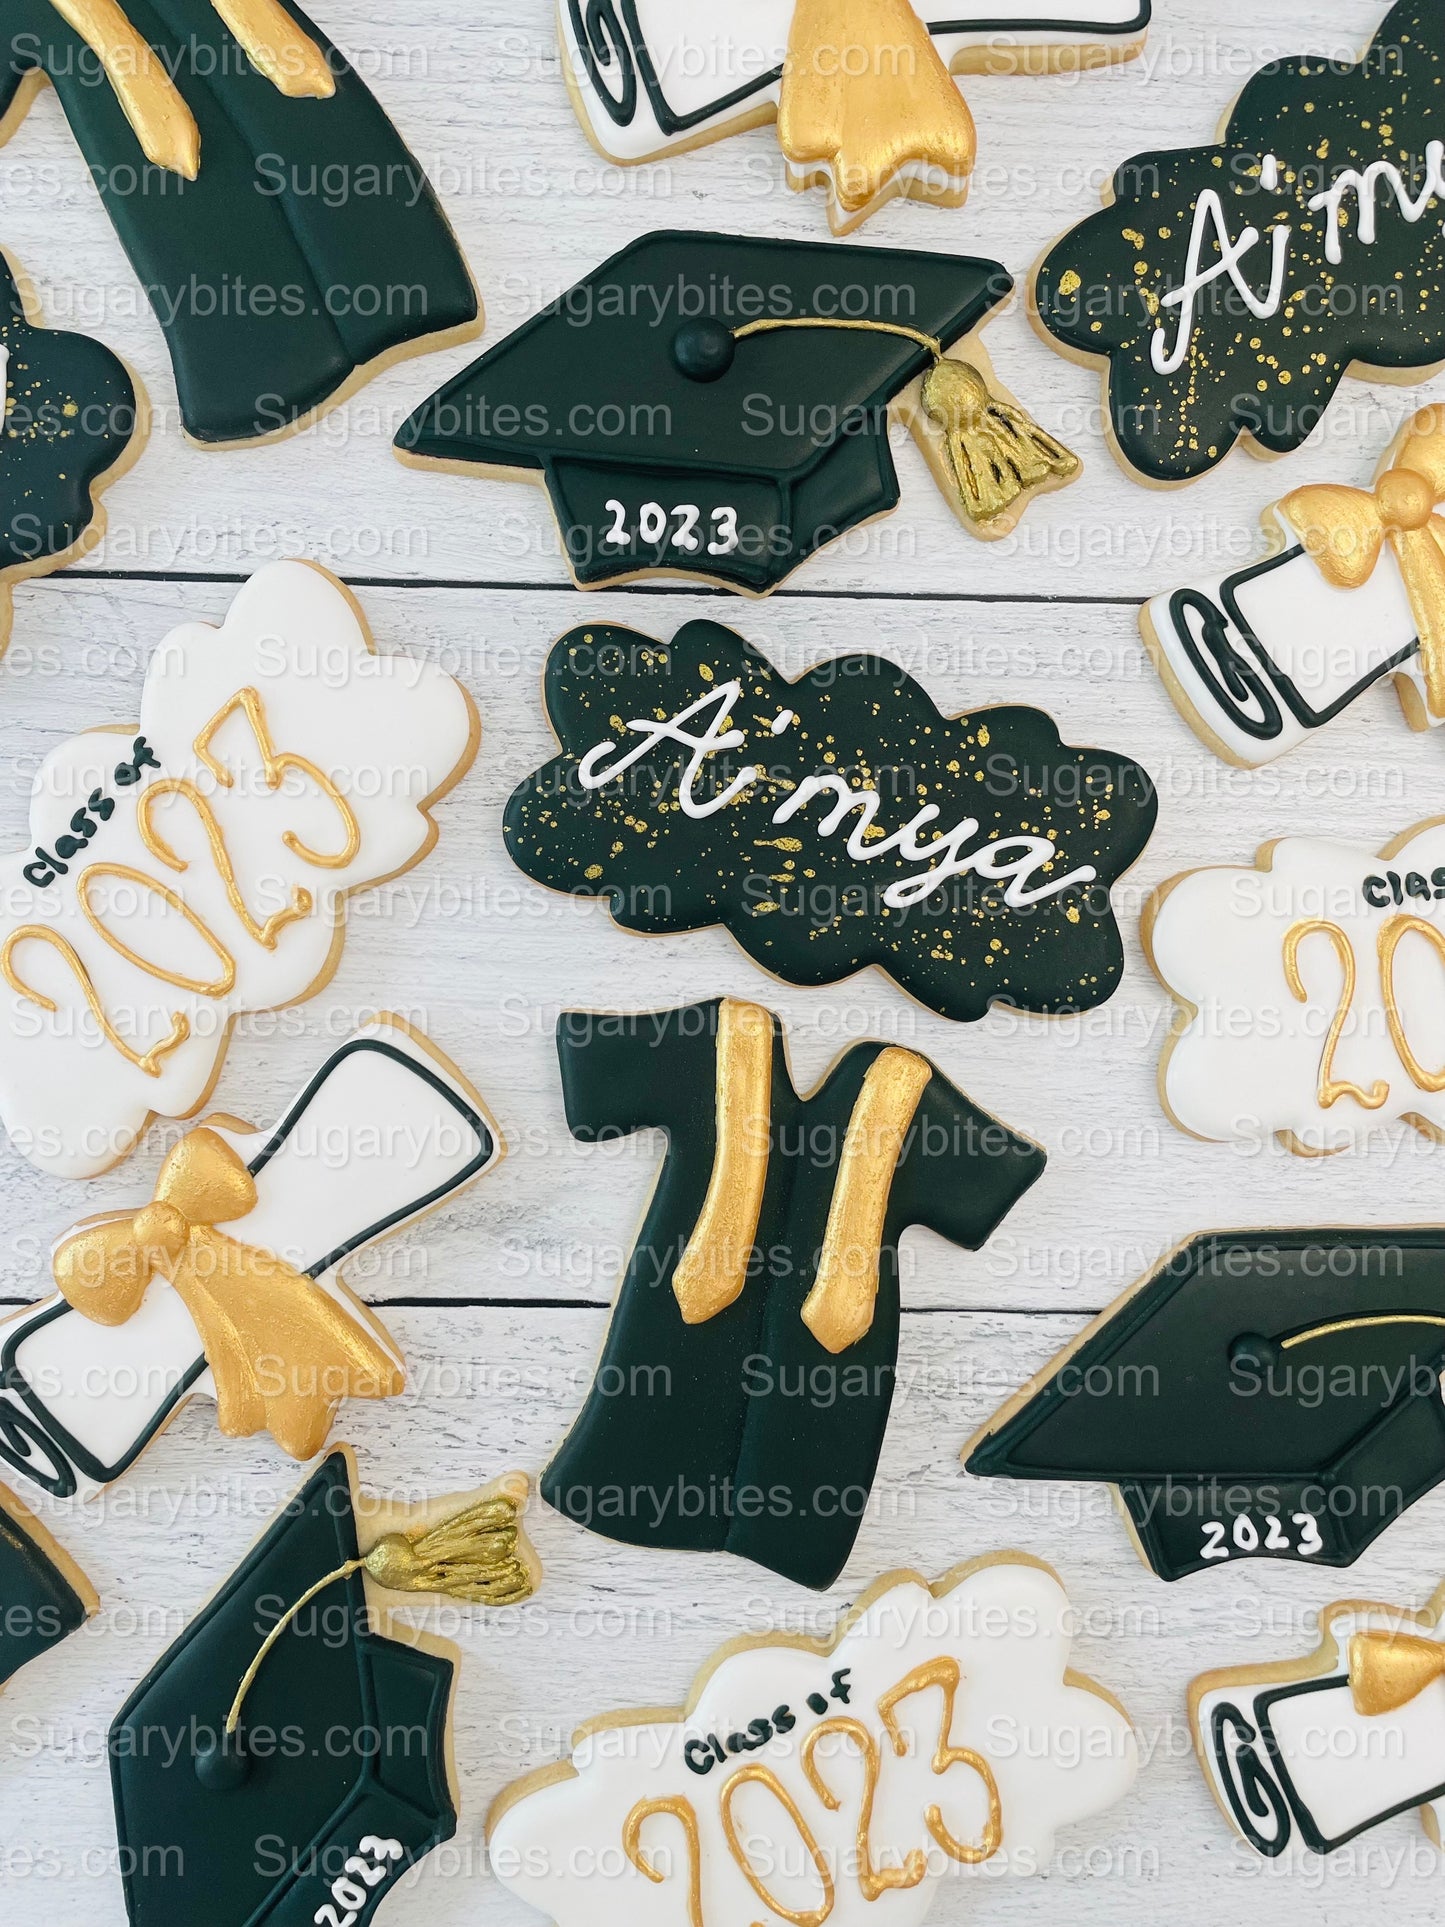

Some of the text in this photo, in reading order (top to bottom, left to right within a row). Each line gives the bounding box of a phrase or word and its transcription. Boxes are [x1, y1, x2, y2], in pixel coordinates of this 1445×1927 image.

[605, 499, 739, 556] 2023
[114, 736, 161, 786] of
[3, 686, 359, 1076] 2023
[1200, 1513, 1323, 1559] 2023
[806, 1667, 851, 1715] of
[622, 1655, 1003, 1927] 2023
[314, 1835, 403, 1927] 2023
